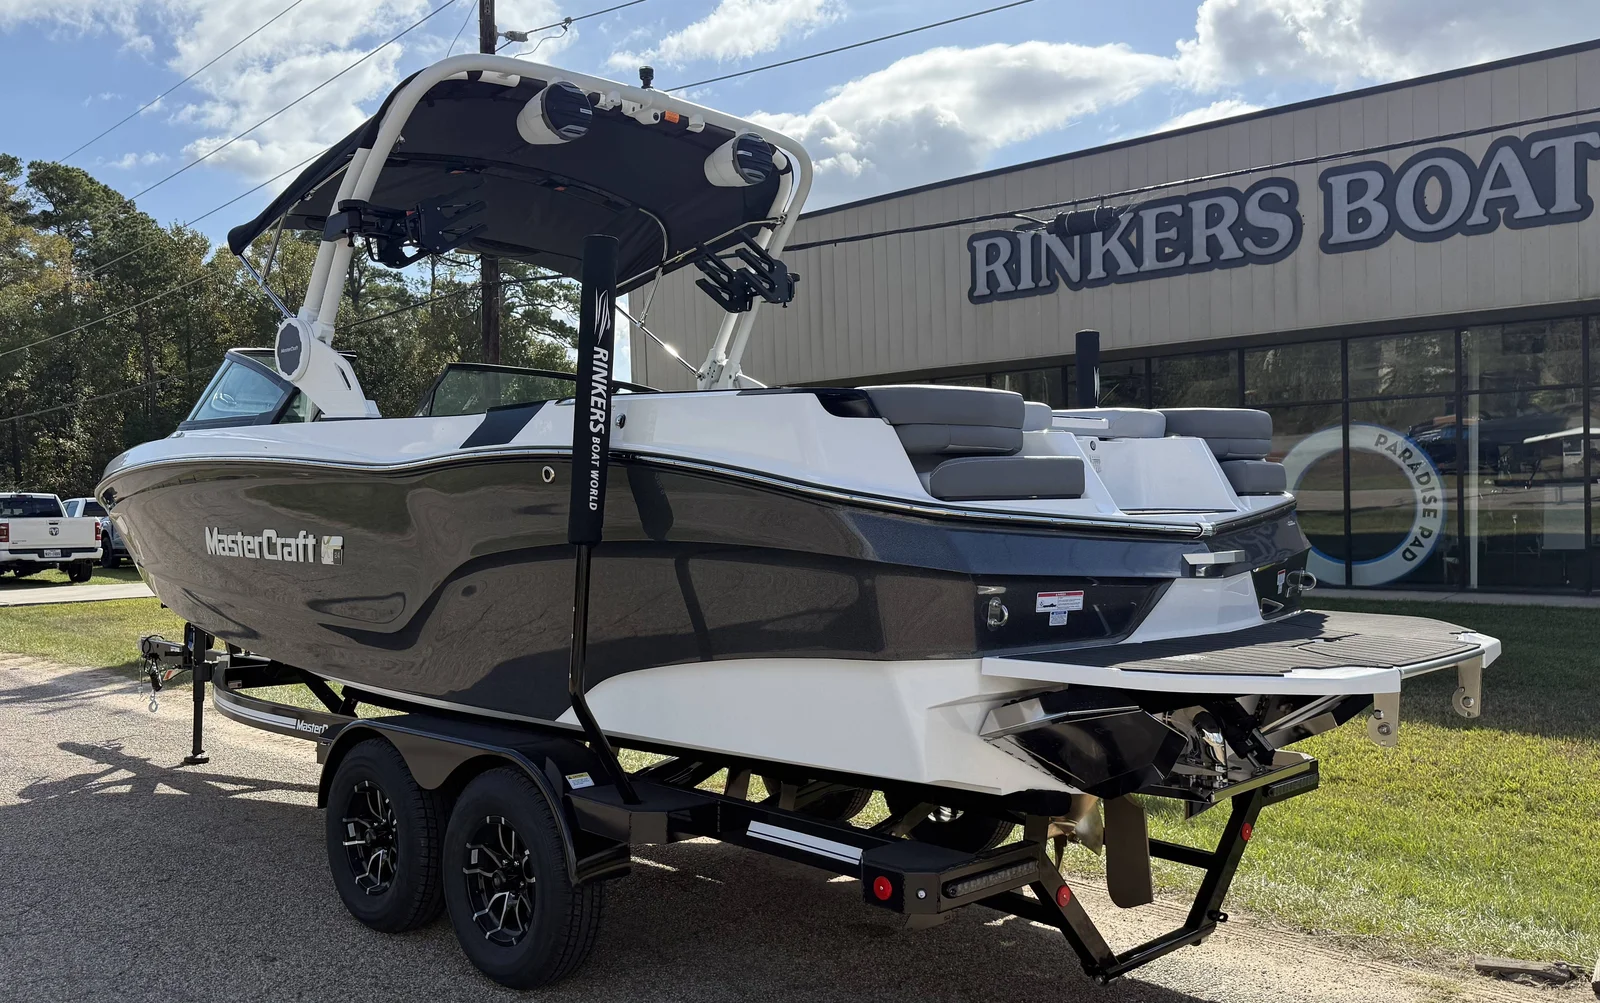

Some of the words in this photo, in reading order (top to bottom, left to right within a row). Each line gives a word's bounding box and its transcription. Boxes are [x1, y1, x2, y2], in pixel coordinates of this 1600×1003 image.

[972, 186, 1297, 298] RINKERS
[1327, 131, 1600, 246] BOAT
[589, 346, 608, 435] RINKERS
[591, 436, 600, 467] BOAT
[589, 470, 599, 511] WORLD
[1374, 434, 1438, 519] PARADISE
[205, 526, 316, 563] MasterCraft
[1401, 526, 1433, 562] PAD
